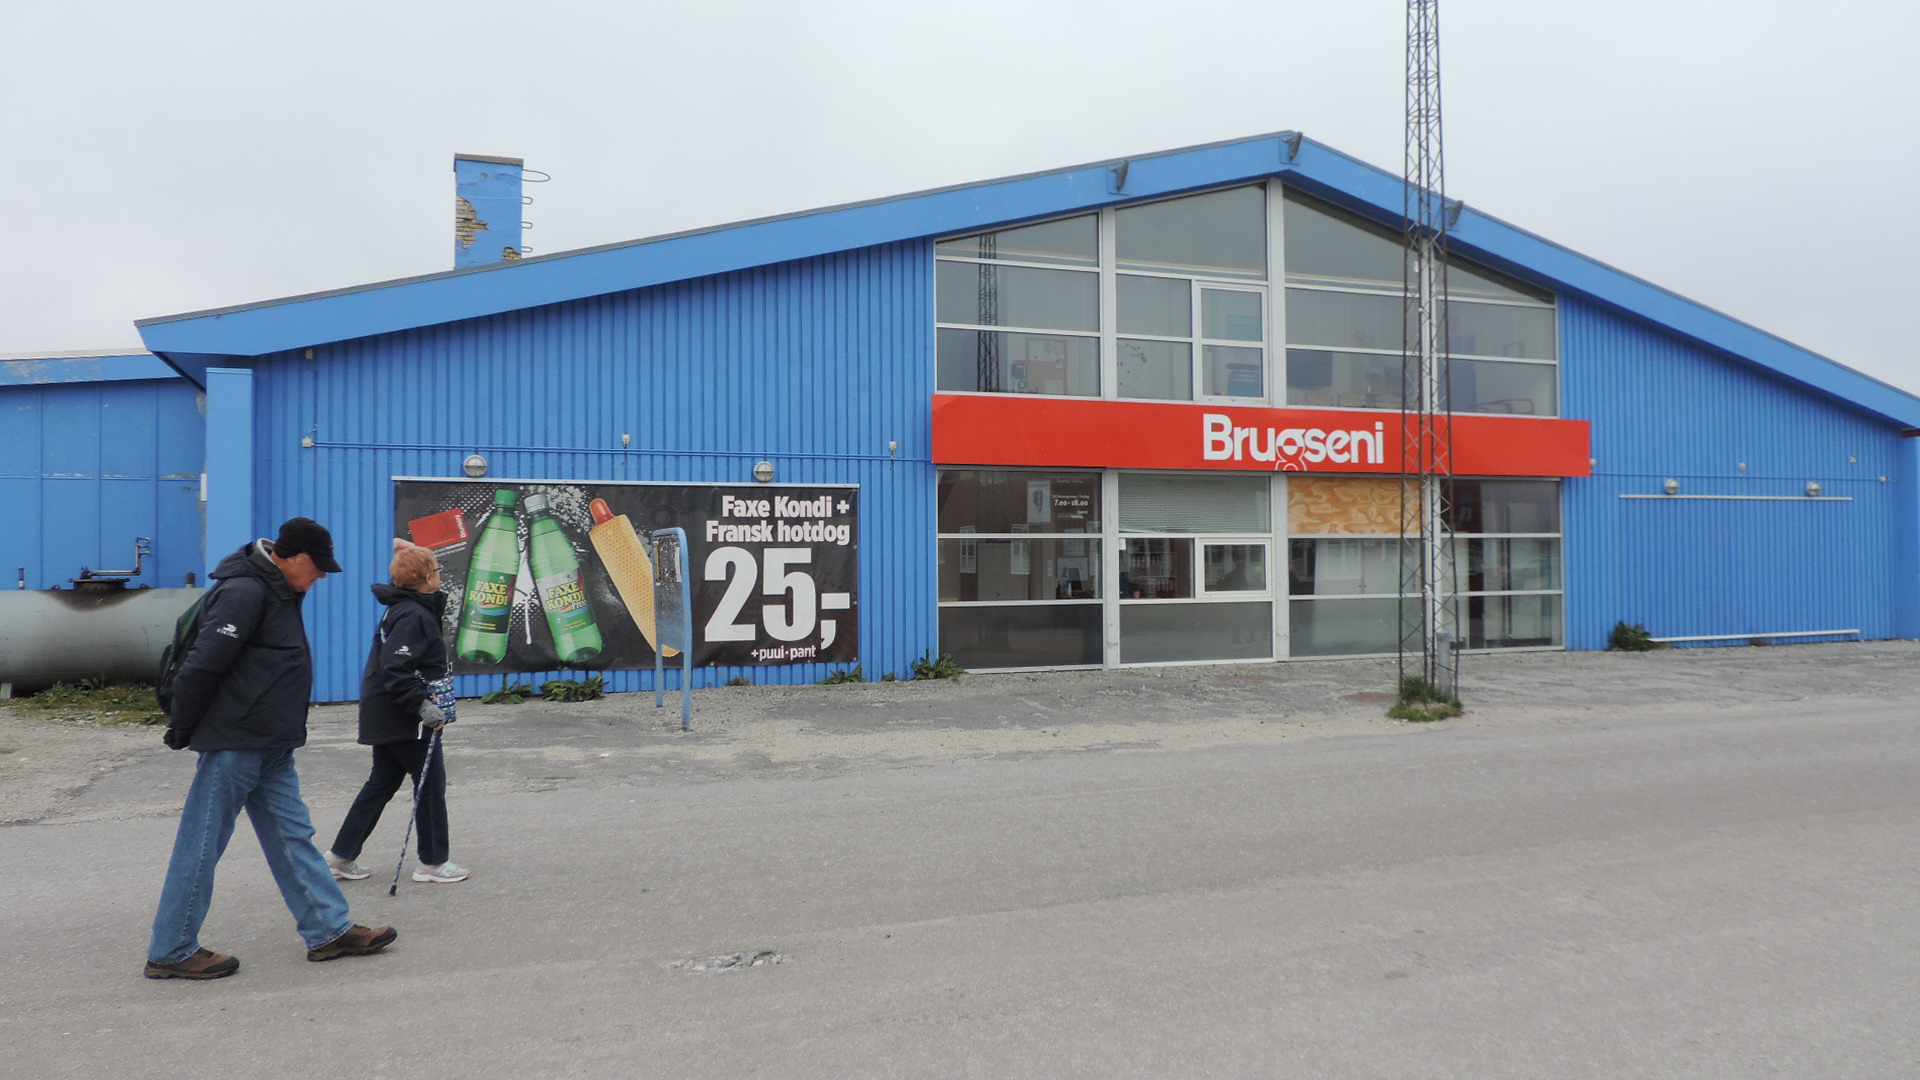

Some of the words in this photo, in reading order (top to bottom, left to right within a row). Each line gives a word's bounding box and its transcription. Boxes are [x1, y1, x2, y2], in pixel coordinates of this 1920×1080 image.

[1203, 413, 1384, 471] Brugseni
[722, 495, 771, 518] Faxe
[774, 496, 832, 518] Kondi
[706, 520, 773, 542] Fransk
[777, 520, 850, 546] hotdog
[469, 590, 509, 605] KONDI
[475, 581, 507, 595] FAXE
[547, 580, 579, 598] FAXE
[545, 591, 585, 610] KONDI
